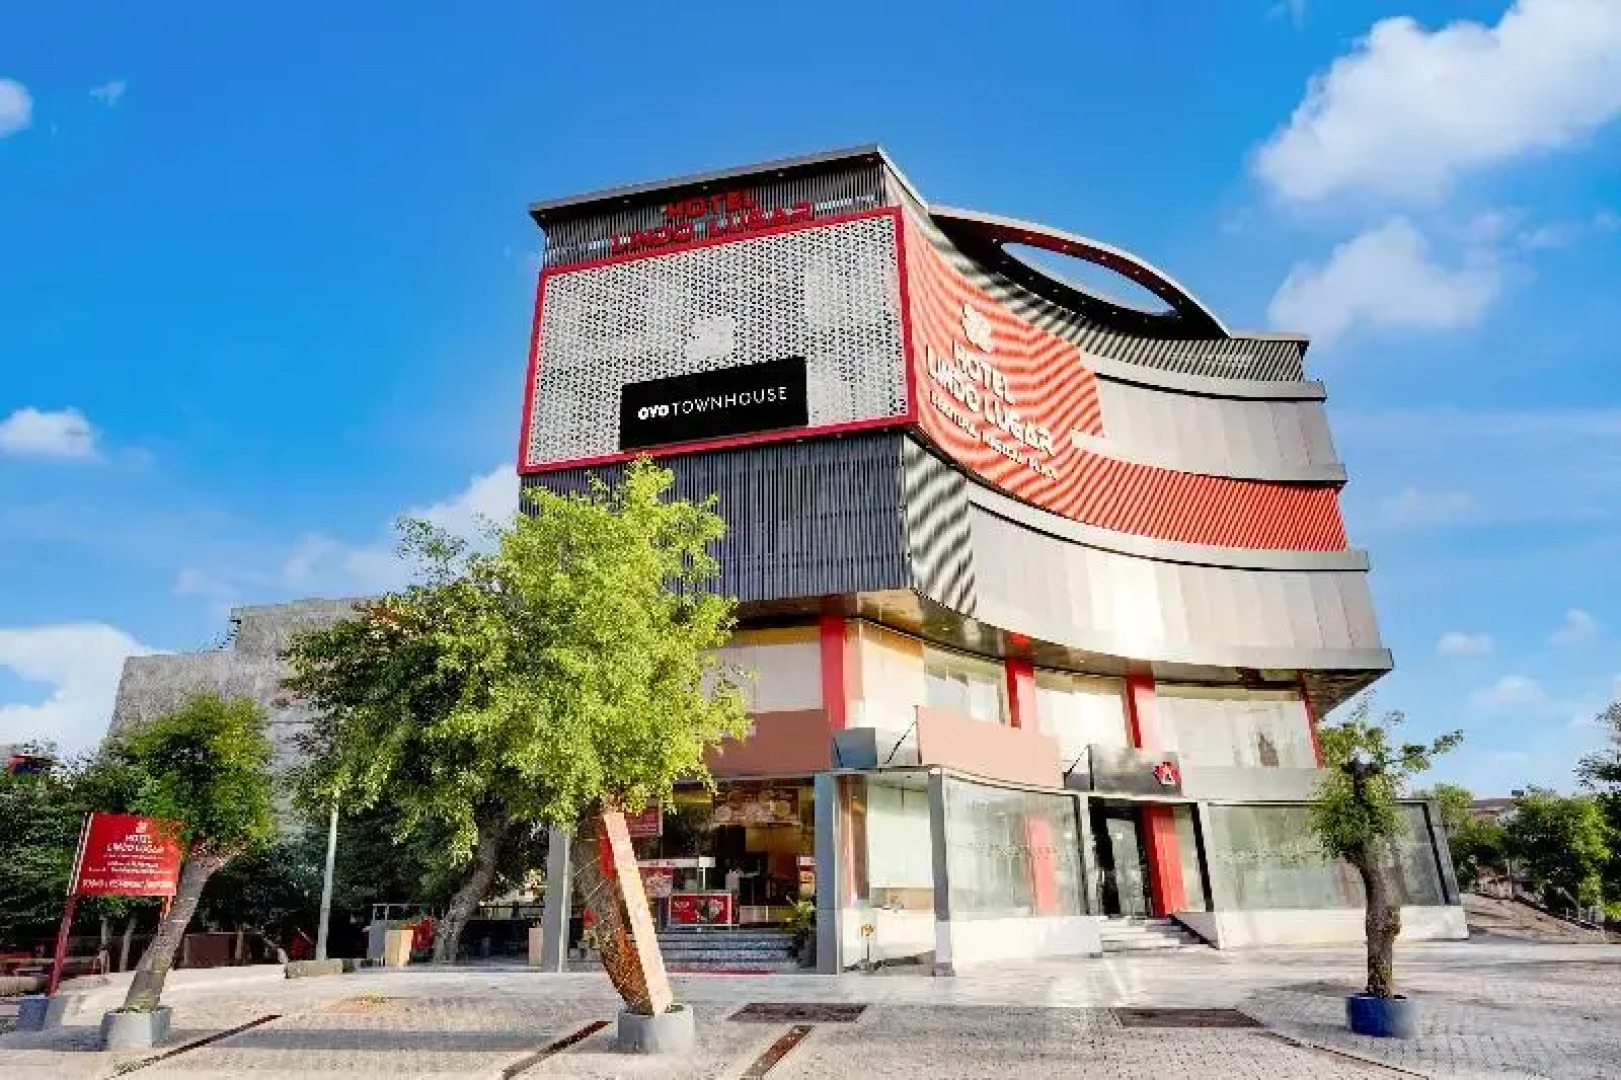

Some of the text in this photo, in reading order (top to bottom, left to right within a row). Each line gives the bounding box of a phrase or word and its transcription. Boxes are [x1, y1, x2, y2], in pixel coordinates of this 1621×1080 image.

[665, 190, 756, 219] HOTEL
[952, 338, 1016, 406] HOTEL
[637, 386, 787, 420] OYO TOWNHOUSE
